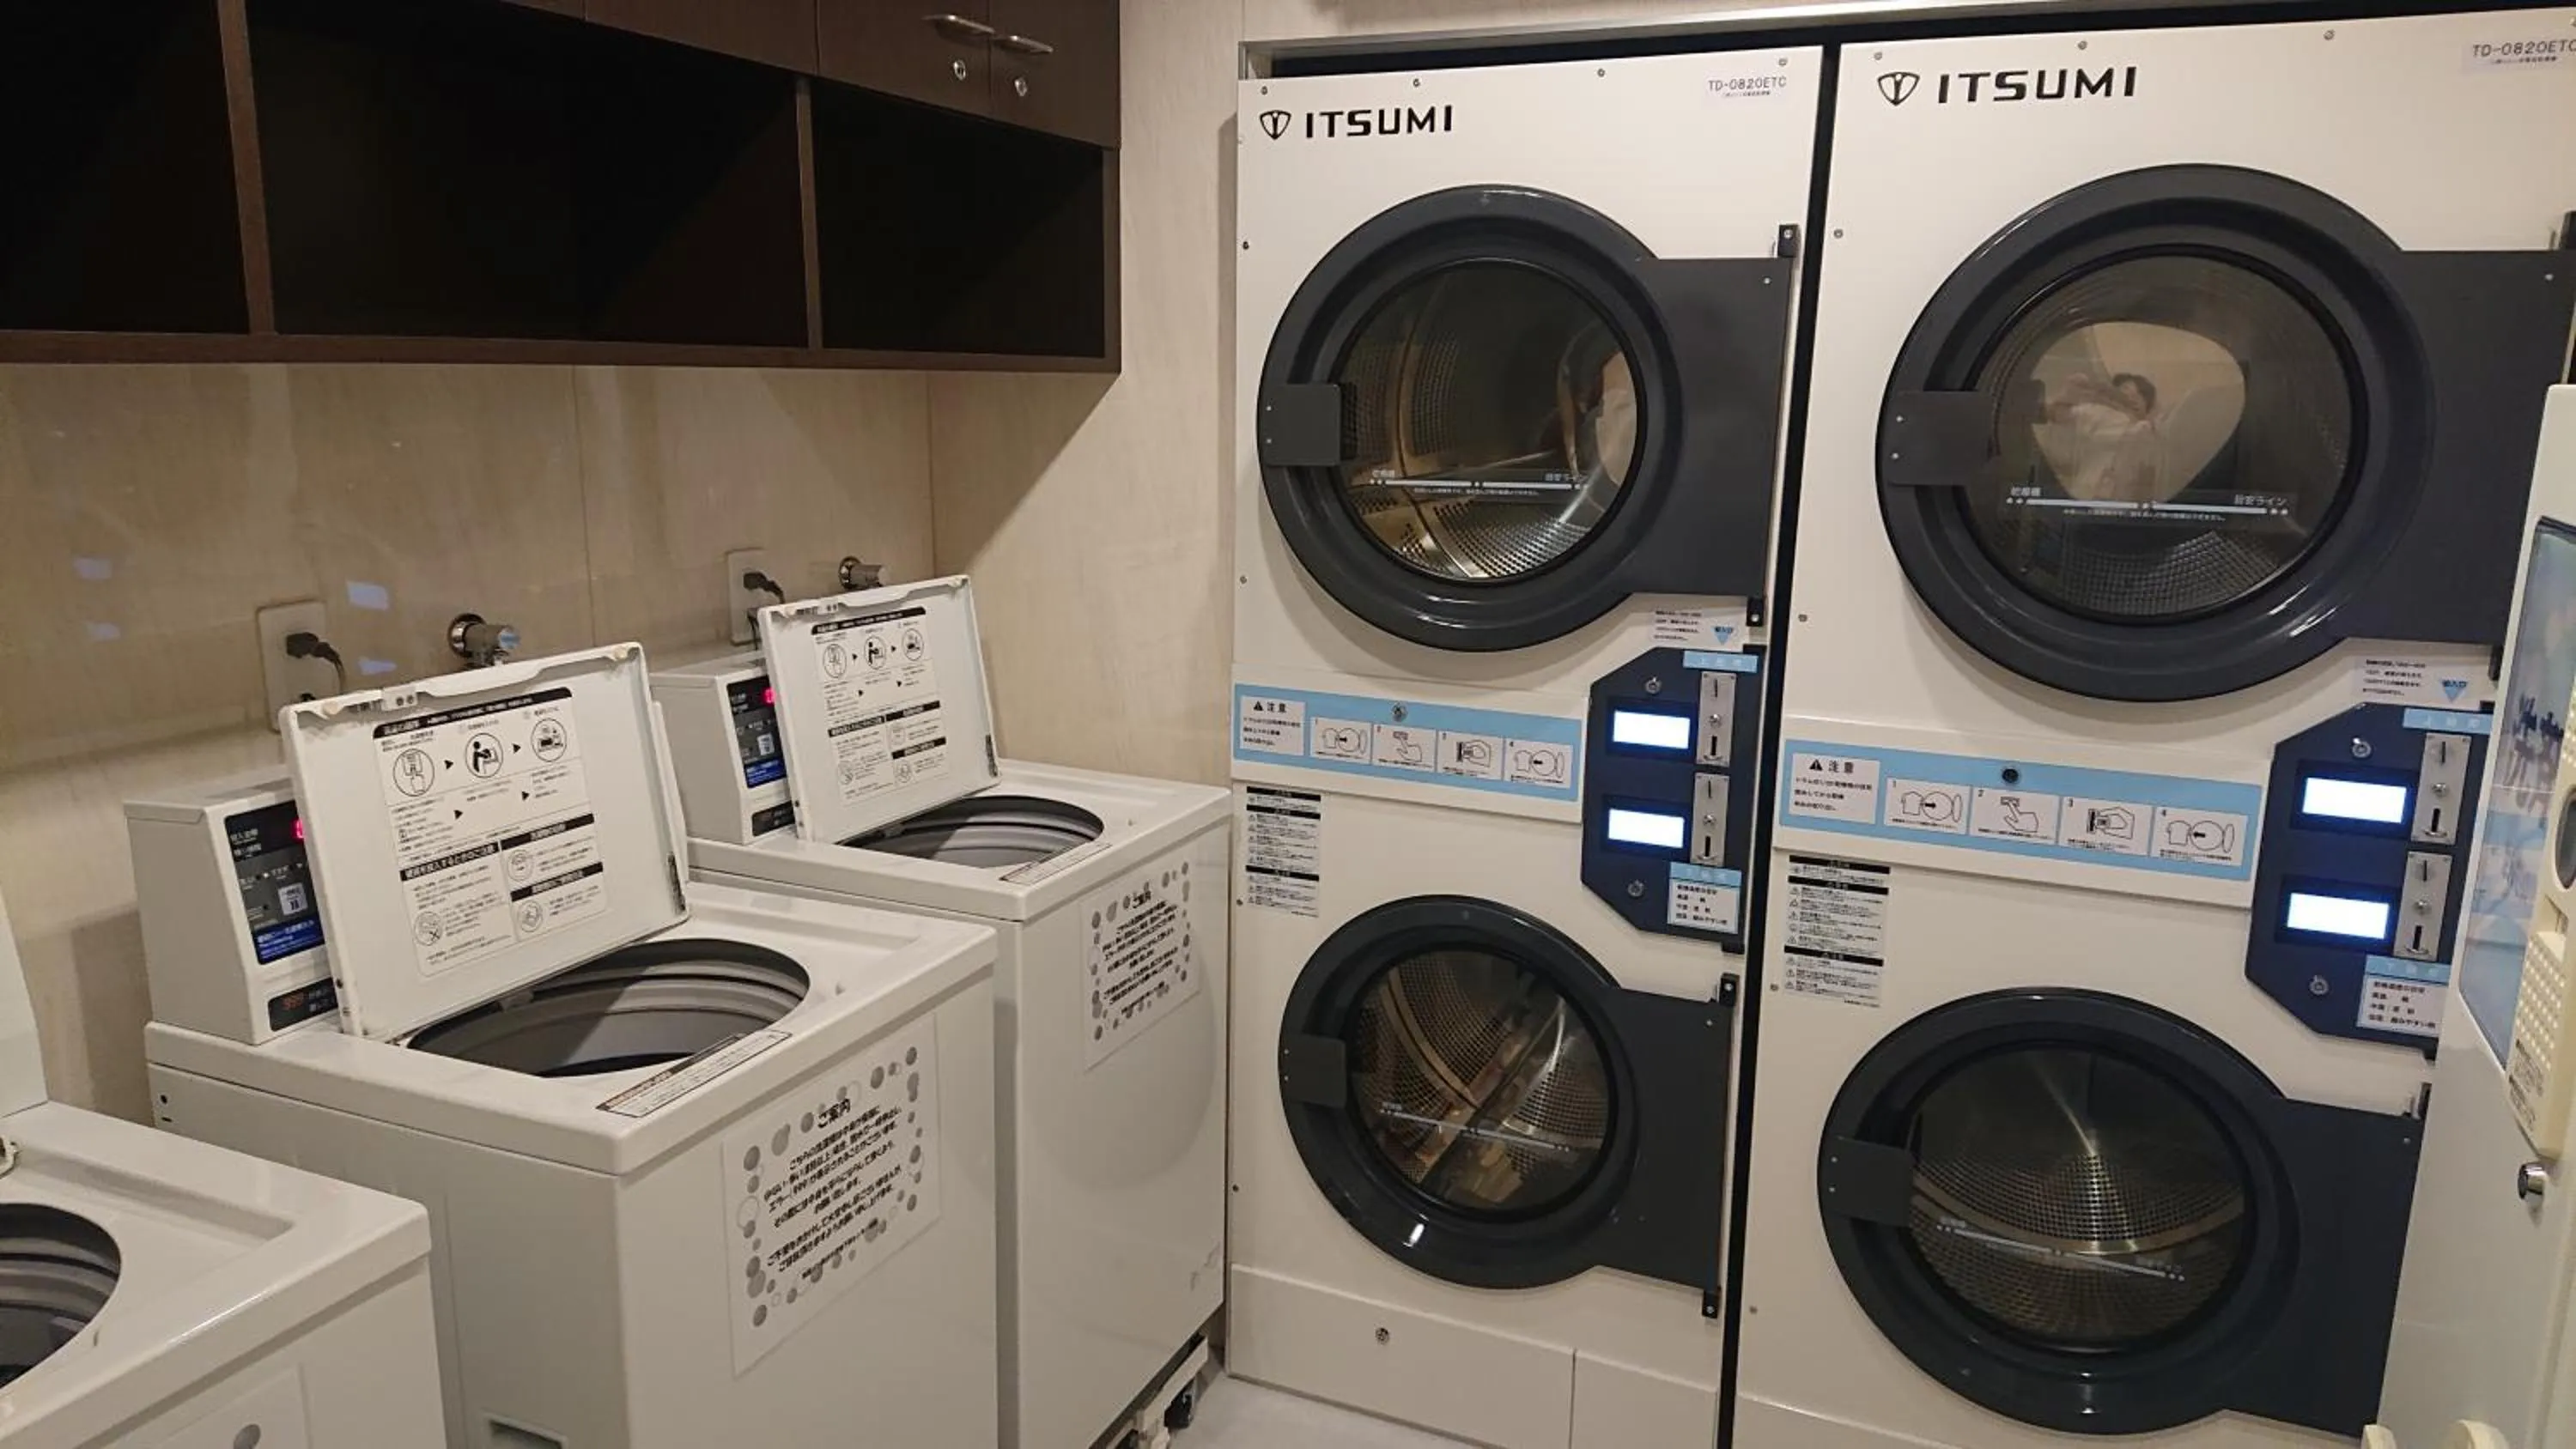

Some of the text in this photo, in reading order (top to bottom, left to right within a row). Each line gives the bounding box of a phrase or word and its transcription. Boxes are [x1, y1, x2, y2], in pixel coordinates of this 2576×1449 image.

[1708, 76, 1787, 92] TD-0820ETC
[1937, 66, 2138, 105] ITSUMI
[1306, 106, 1453, 139] ITSUMI
[1828, 761, 1854, 773] 注意
[817, 1098, 851, 1129] ご案内
